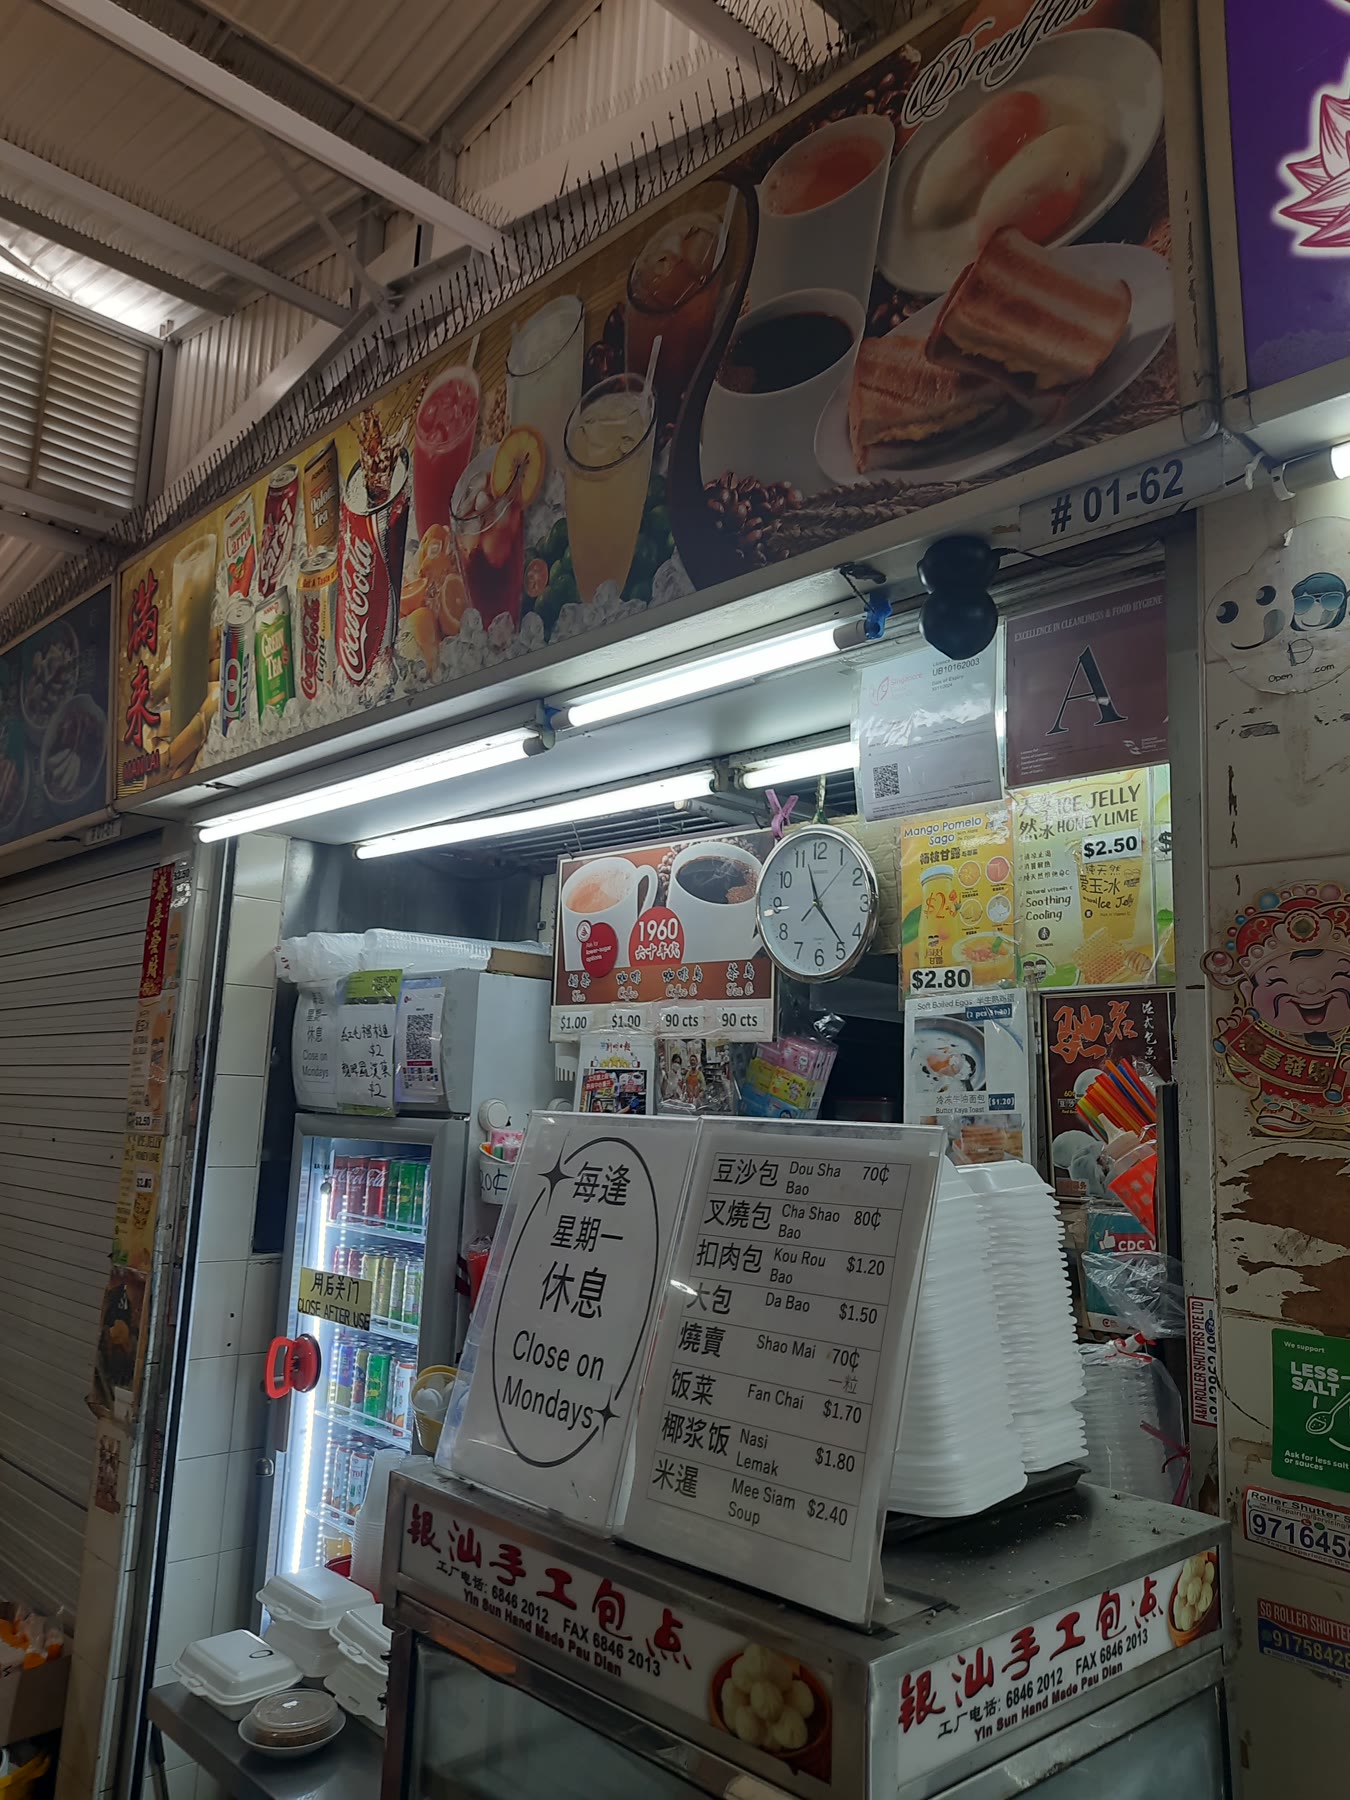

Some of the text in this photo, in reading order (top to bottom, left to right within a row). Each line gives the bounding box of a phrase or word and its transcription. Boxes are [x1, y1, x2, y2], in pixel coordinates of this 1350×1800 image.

[904, 0, 1093, 125] Breakfast
[1051, 458, 1183, 535] # 01-62
[1014, 595, 1163, 643] EXCELLENCE CLEANLINESS FOOD HYGIENE
[932, 657, 981, 677] UB10162003
[1268, 672, 1294, 683] Open
[1045, 643, 1129, 737] A
[1085, 783, 1141, 809] JELLY
[904, 823, 940, 838] Mango
[942, 815, 982, 831] Pomelo
[1056, 808, 1139, 834] HONEY LIME
[929, 832, 955, 846] Sago
[1083, 835, 1138, 859] $2.50
[794, 849, 806, 868] 11
[812, 841, 827, 860] 12
[838, 846, 845, 867] 1
[779, 870, 792, 889] 10
[852, 867, 863, 886] 2
[859, 894, 870, 913] 3
[1025, 893, 1072, 908] Soothing
[1025, 908, 1063, 922] Cooling
[638, 918, 679, 941] 1960
[778, 922, 789, 941] 8
[852, 921, 862, 939] 4
[634, 941, 681, 960] 六十年代
[794, 942, 804, 960] 7
[814, 948, 825, 966] 6
[836, 941, 846, 960] 5
[911, 969, 972, 991] $2.80
[917, 999, 955, 1010] Soft Boiled
[560, 1013, 758, 1031] $1.00 $1.00 90 cts 90 cts
[302, 1050, 328, 1061] Close on
[368, 1043, 384, 1057] $2
[302, 1065, 329, 1080] Mondays
[368, 1080, 387, 1098] $2
[967, 1105, 985, 1114] Toast
[572, 1161, 632, 1206] 每逢
[713, 1158, 890, 1188] 豆沙包 Dou Sha 70¢
[785, 1181, 809, 1196] Bao
[703, 1199, 882, 1231] 叉燒包 Cha Shao 80¢
[550, 1214, 624, 1253] 星期一
[778, 1223, 801, 1240] Bao
[1118, 1239, 1146, 1253] CDC
[696, 1238, 885, 1277] 扣肉包 Kou Rou $1.20
[769, 1268, 793, 1285] Bao
[539, 1260, 608, 1320] 休息
[686, 1282, 878, 1325] 大包 Da Bao $1.50
[297, 1297, 371, 1332] CLOSE AFTER USE
[512, 1329, 605, 1382] Close on
[677, 1320, 861, 1373] 燒賣 Shao Mai 70¢
[1191, 1300, 1207, 1402] ROLLER SHUTTERS PTE LTD
[1283, 1341, 1325, 1354] We support
[1290, 1361, 1339, 1382] LESS
[828, 1374, 859, 1395] 一粒
[1291, 1376, 1340, 1397] SALT
[501, 1375, 595, 1432] Mondays
[671, 1368, 862, 1425] 饭菜 Fan Chai $1.70
[661, 1410, 855, 1473] 椰浆饭 Nasi $1.80
[735, 1451, 779, 1478] Lemak
[1284, 1449, 1350, 1470] Ask for less salt
[1295, 1460, 1324, 1471] sauces
[731, 1477, 760, 1500] Mee
[762, 1486, 796, 1511] Siam
[807, 1498, 848, 1527] $2.40
[1251, 1491, 1340, 1520] Roller Shutter
[728, 1501, 760, 1527] Soup
[1273, 1604, 1310, 1630] ROLLER
[482, 1597, 502, 1619] Sun
[504, 1608, 533, 1637] Hand
[535, 1621, 565, 1649] Made
[568, 1638, 591, 1663] Pau
[491, 1582, 518, 1609] 6846
[521, 1597, 550, 1625] 2012
[563, 1617, 589, 1644] FAX
[592, 1631, 625, 1659] 6846
[628, 1647, 662, 1678] 2013
[1005, 1680, 1034, 1709] 6846
[1036, 1667, 1064, 1696] 2012
[1075, 1650, 1098, 1676] FAX
[1099, 1637, 1124, 1665] 6846
[1125, 1627, 1149, 1654] 2013
[996, 1715, 1018, 1734] Sun
[1021, 1699, 1049, 1724] Hand
[1051, 1684, 1079, 1707] Made
[1080, 1674, 1099, 1693] Pau
